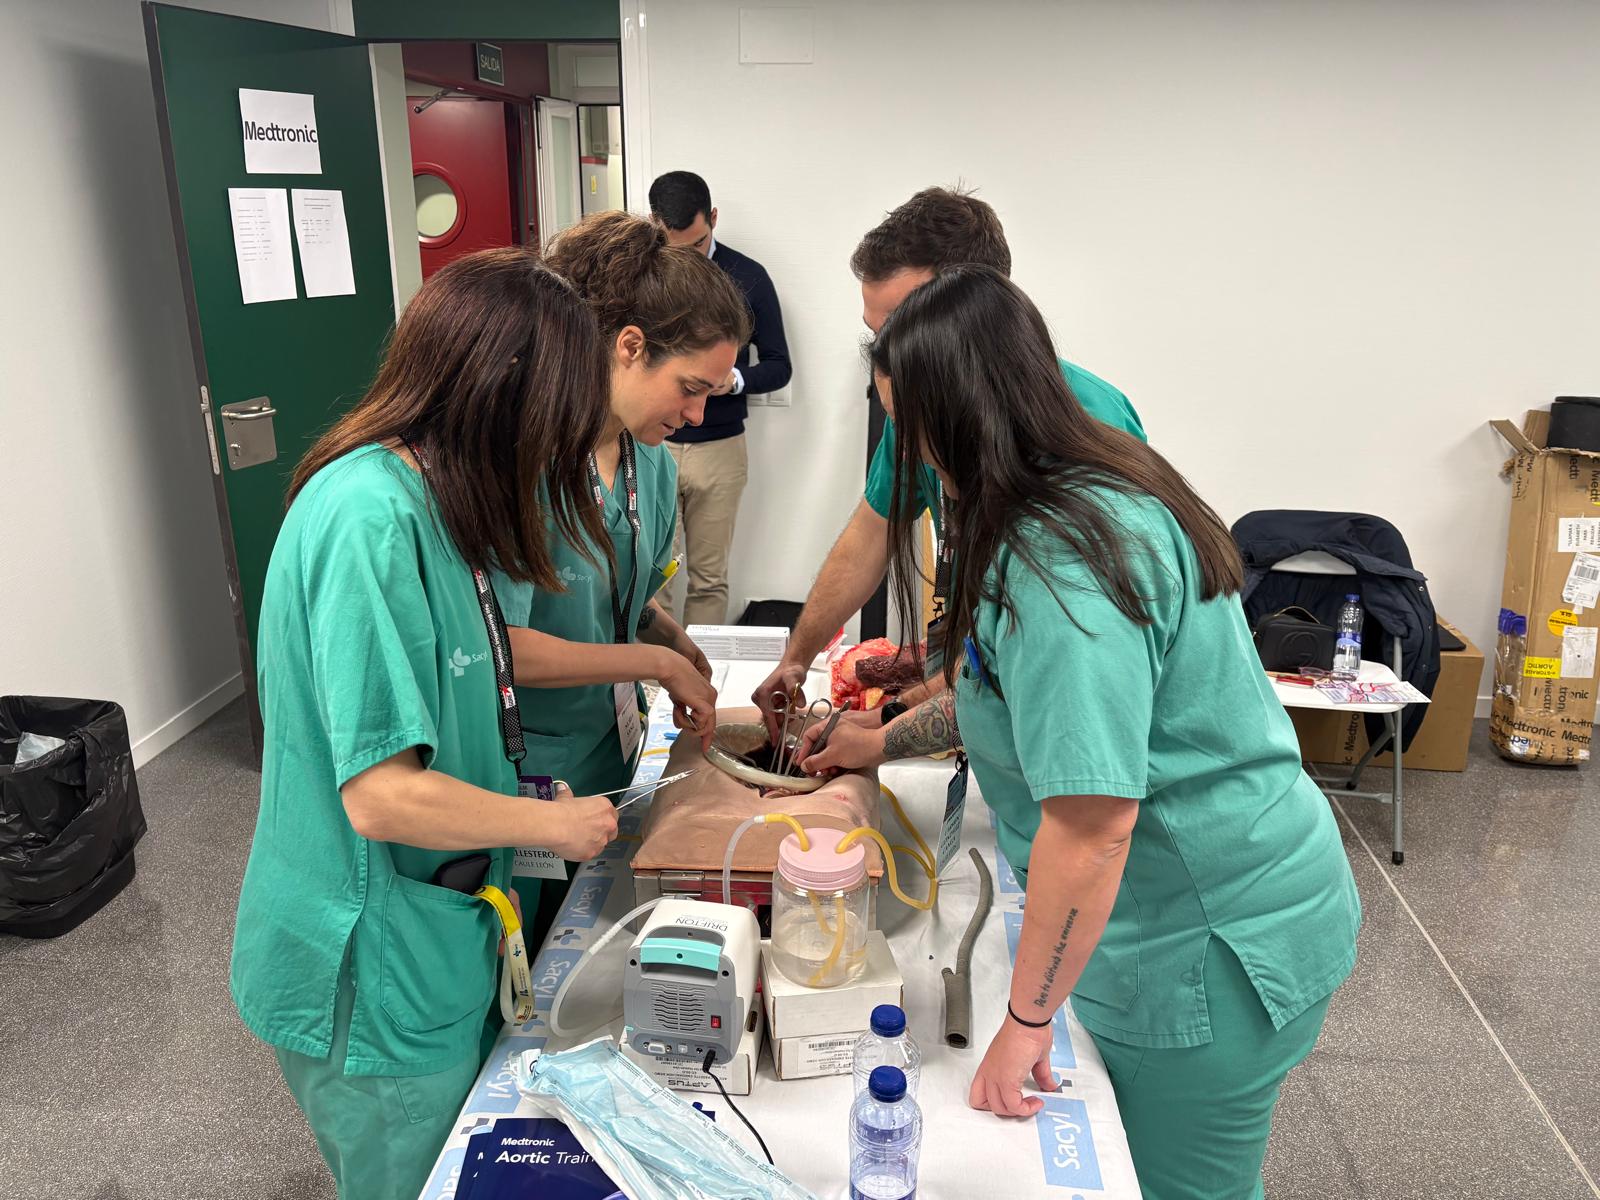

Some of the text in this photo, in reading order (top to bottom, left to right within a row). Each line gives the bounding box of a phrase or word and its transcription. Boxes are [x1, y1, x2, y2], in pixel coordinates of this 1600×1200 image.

[480, 55, 500, 73] SALIDA
[244, 121, 317, 143] Medtronic
[667, 1079, 711, 1088] APTUS
[501, 1137, 555, 1147] Medtronic
[1045, 1111, 1081, 1170] Sacyl
[495, 1151, 551, 1164] Aortic
